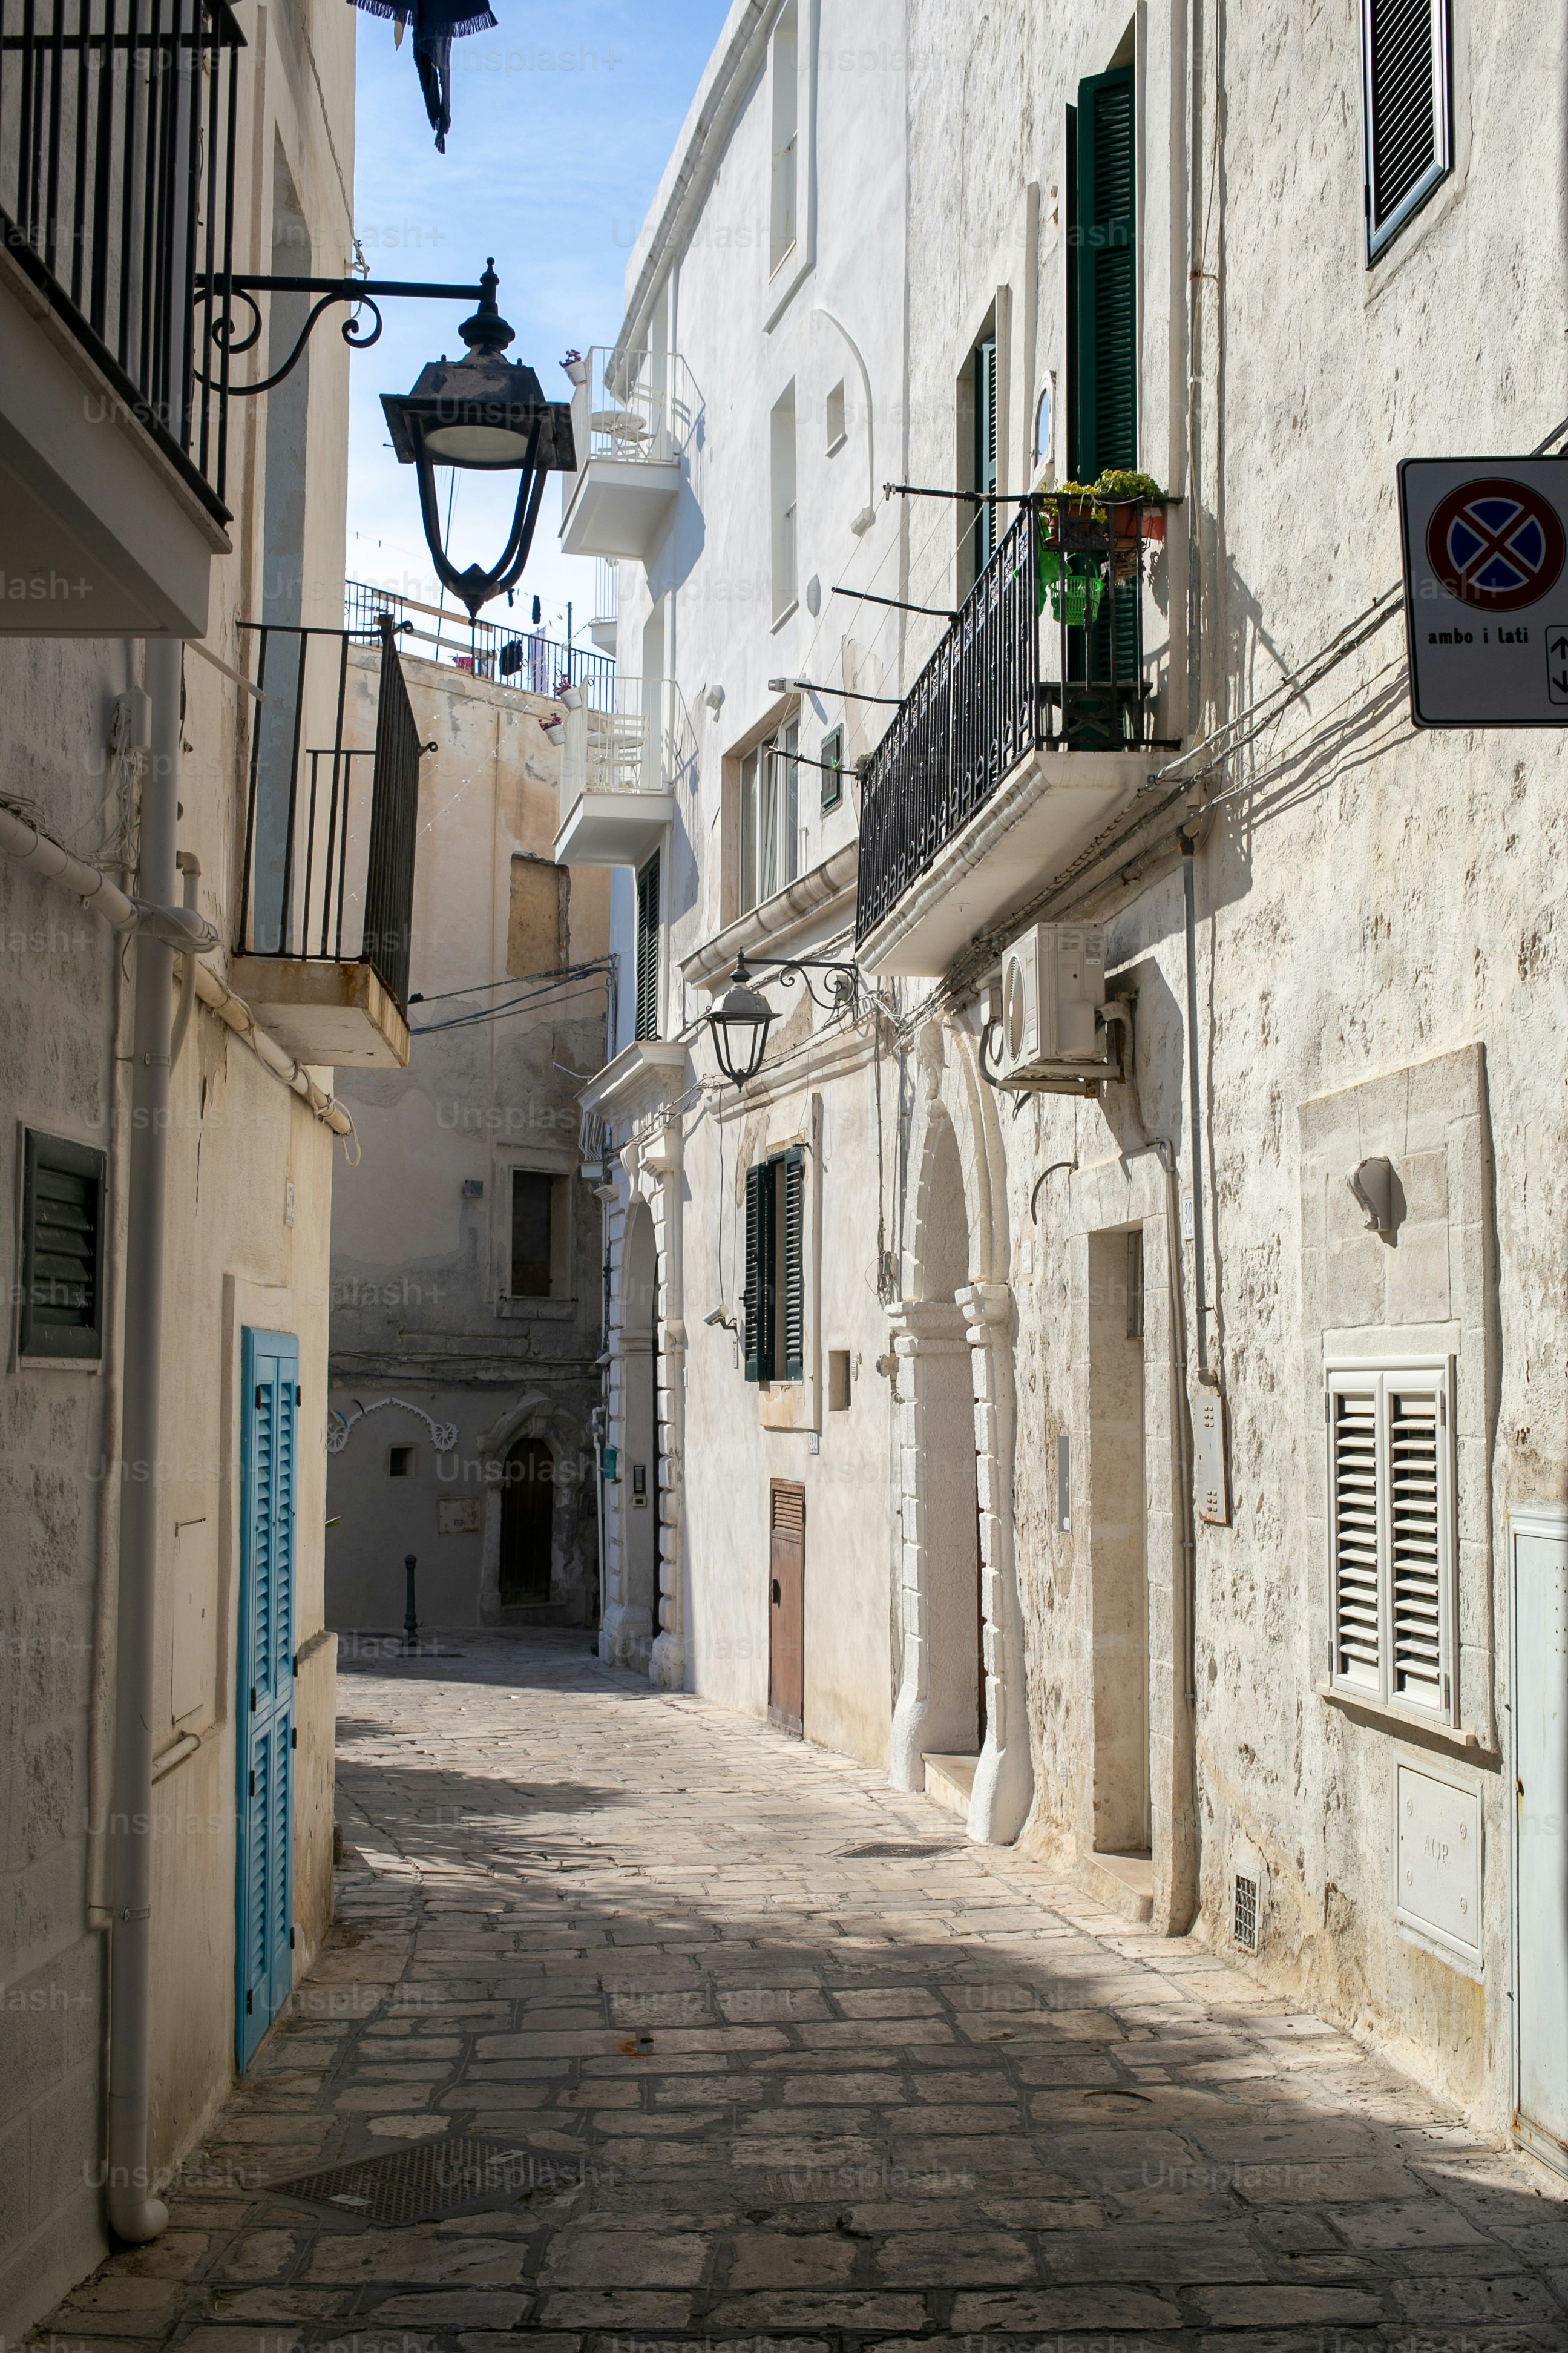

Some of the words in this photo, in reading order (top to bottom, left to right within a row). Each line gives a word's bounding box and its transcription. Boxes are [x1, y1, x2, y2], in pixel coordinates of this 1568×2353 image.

[1428, 627, 1473, 645] ambo
[1483, 627, 1488, 644] i
[1498, 627, 1529, 644] lati
[1184, 1202, 1192, 1225] 30
